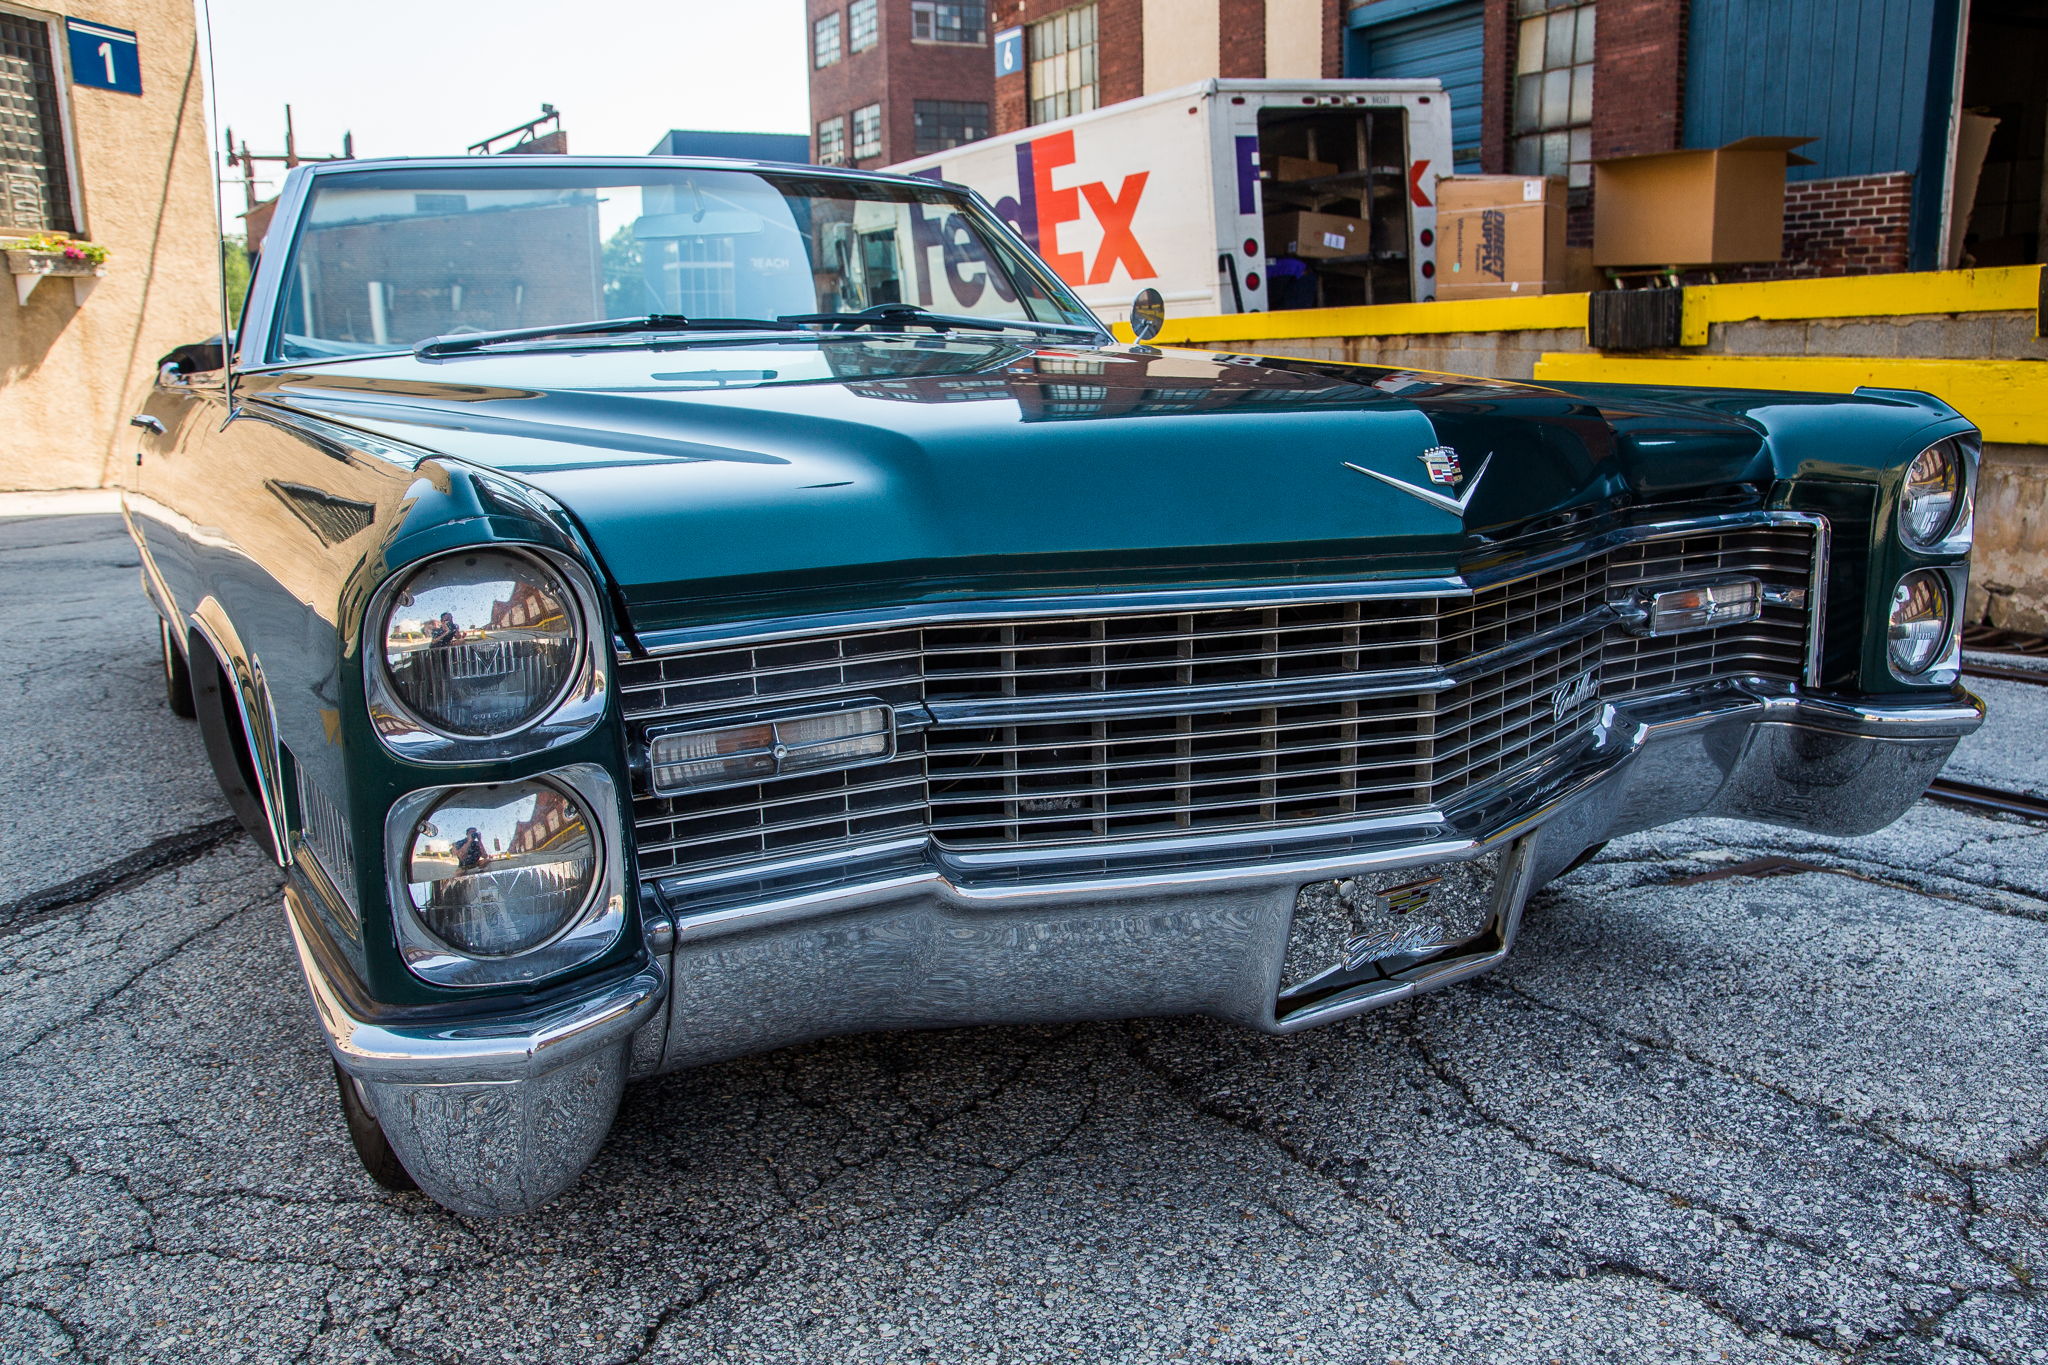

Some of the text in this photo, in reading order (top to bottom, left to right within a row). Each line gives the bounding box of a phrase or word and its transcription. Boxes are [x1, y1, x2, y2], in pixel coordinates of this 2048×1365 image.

[98, 42, 116, 84] 1
[1004, 40, 1013, 70] 6
[909, 129, 1159, 308] FedEx
[1482, 209, 1493, 273] SUPPLY
[1493, 210, 1505, 282] DIRECT
